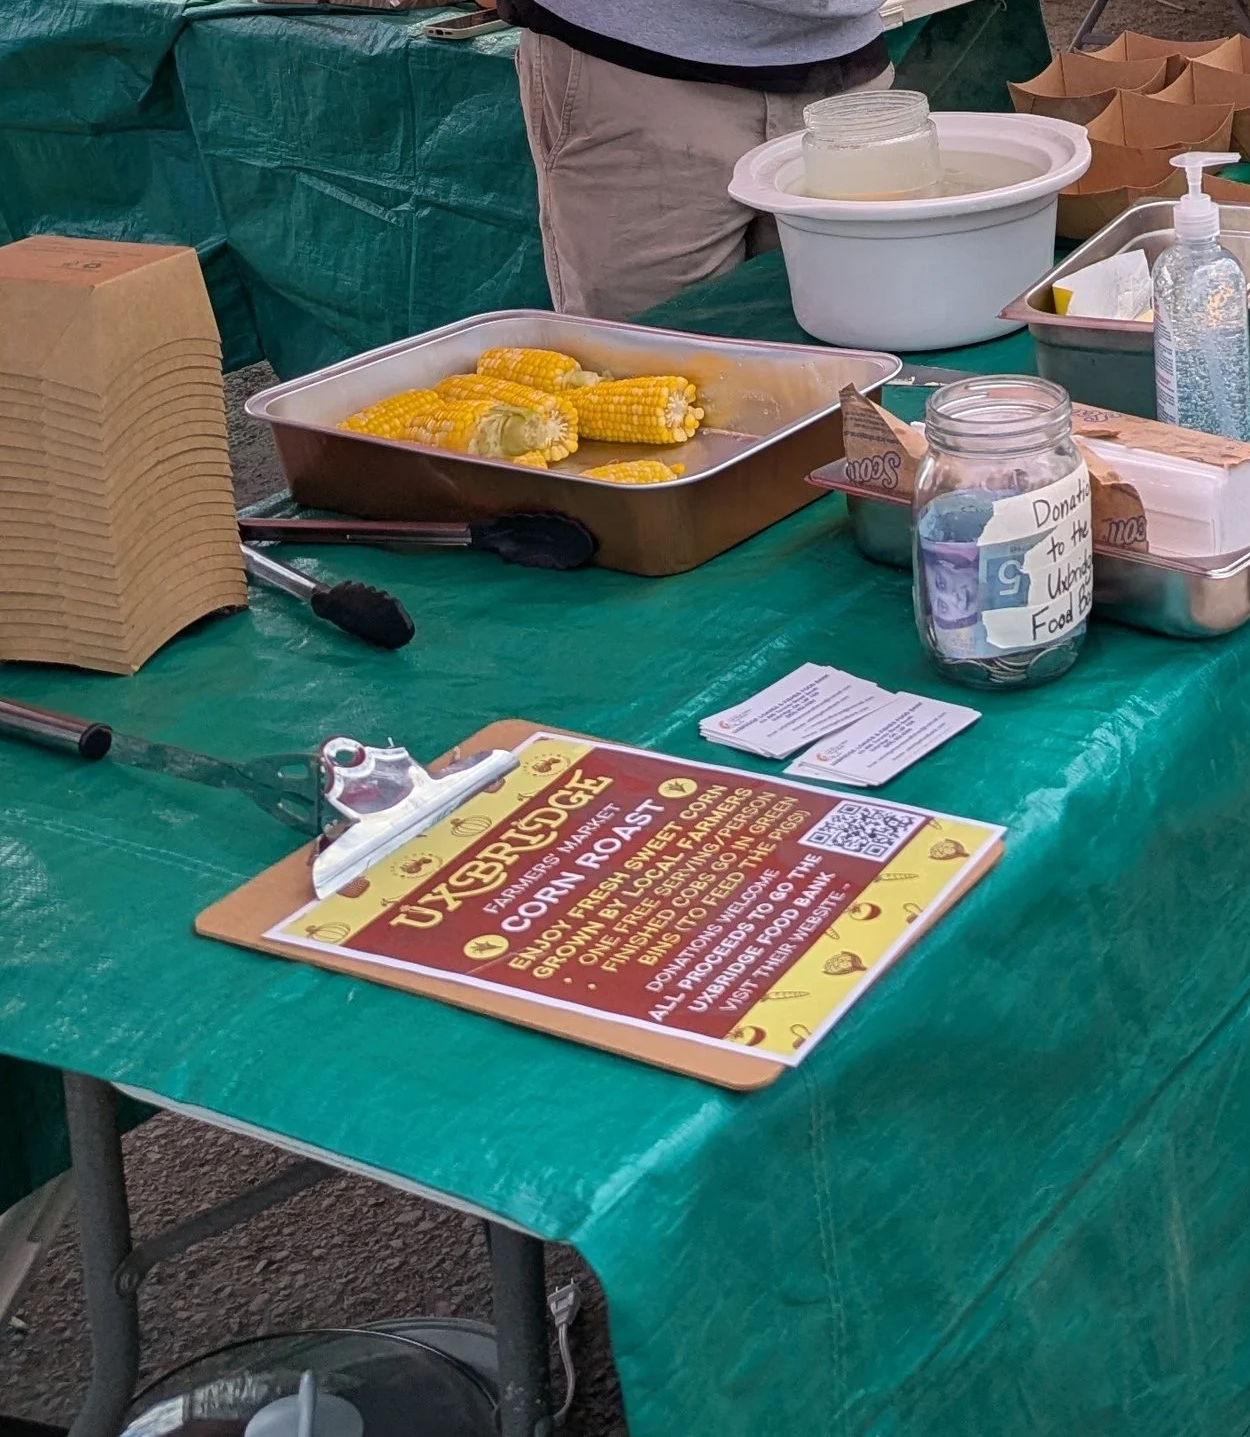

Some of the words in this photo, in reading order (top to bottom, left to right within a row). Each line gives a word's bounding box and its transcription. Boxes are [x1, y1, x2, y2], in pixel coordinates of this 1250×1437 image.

[1032, 591, 1074, 641] Food
[1047, 536, 1065, 562] to
[390, 769, 613, 928] UXBRIDGE
[483, 853, 561, 914] FARMERS'
[557, 802, 621, 853] MARKET
[501, 871, 585, 932] CORN
[575, 798, 664, 869] ROAST
[508, 919, 572, 971] ENJOY
[567, 871, 630, 919] FRESH
[624, 821, 683, 871] SWEET
[679, 784, 728, 821] CORN
[532, 921, 605, 979] GROWN
[598, 898, 628, 920] BY
[621, 852, 685, 898] LOCAL
[677, 787, 753, 850] FARMERS
[578, 934, 622, 966] ONE
[612, 897, 661, 934] FREE
[654, 791, 777, 896] SERVING/PERSON
[600, 909, 676, 973] FINISHED
[672, 872, 716, 908] COBS
[711, 852, 737, 871] GO
[731, 835, 755, 851] IN
[749, 796, 799, 834] GREEN
[637, 932, 681, 966] BINS
[674, 907, 707, 931] (TO
[702, 871, 745, 906] FEED
[737, 842, 777, 869] THE
[768, 809, 812, 841] PIGS)
[646, 923, 723, 992] DONATIONS
[716, 868, 781, 923] WELCOME
[648, 992, 686, 1022] ALL
[677, 922, 755, 990] PROCEEDS
[748, 902, 775, 921] TO
[769, 882, 794, 902] GO
[787, 853, 823, 880] THE
[688, 945, 765, 1012] UXBRIDGE
[756, 908, 800, 945] FOOD
[793, 871, 837, 908] BANK
[719, 981, 760, 1012] VISIT
[752, 943, 797, 978] THEIR
[788, 890, 846, 942] WEBSITE
